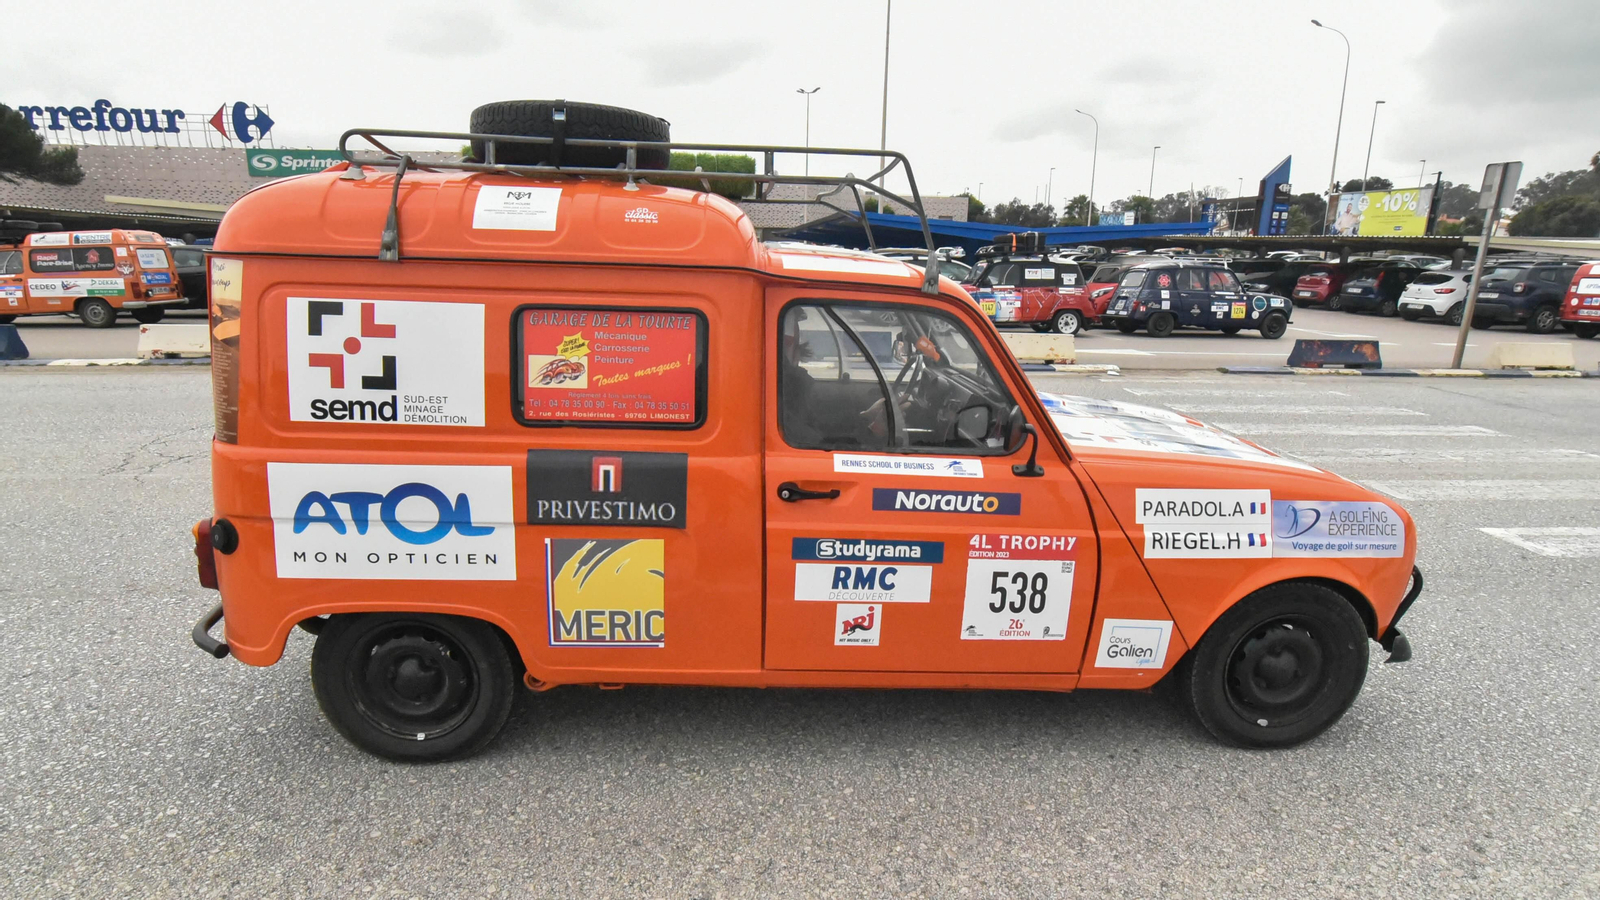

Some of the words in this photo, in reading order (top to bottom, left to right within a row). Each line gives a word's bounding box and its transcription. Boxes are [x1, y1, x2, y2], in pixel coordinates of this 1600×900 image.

[18, 98, 186, 133] rrefour
[1375, 192, 1417, 212] -10%
[36, 254, 58, 262] Rapid
[981, 303, 994, 311] 1147
[1233, 307, 1244, 315] 1274
[529, 311, 588, 326] GARAGE
[592, 313, 611, 327] DE
[615, 314, 632, 328] LA
[639, 314, 692, 330] TOURTE
[594, 331, 648, 342] Mécanique
[594, 342, 651, 354] Carrosserie
[594, 355, 635, 365] Peinture
[592, 372, 630, 388] Toutes
[634, 360, 682, 377] marques
[403, 395, 449, 404] SUD-EST
[549, 400, 559, 408] 04
[561, 400, 570, 408] 78
[573, 400, 582, 408] 35
[584, 400, 594, 409] 00
[596, 400, 606, 410] 90
[613, 401, 627, 410] Fax
[635, 401, 645, 410] 04
[647, 402, 656, 411] 78
[658, 402, 668, 411] 35
[670, 402, 679, 411] 50
[681, 402, 690, 411] 51
[310, 395, 398, 422] semd
[403, 405, 444, 414] MINAGE
[403, 414, 468, 424] DÉMOLITION
[841, 459, 867, 467] RENNES
[868, 460, 893, 469] SCHOOL
[903, 462, 935, 470] BUSINESS
[894, 491, 999, 512] Norauto
[292, 482, 496, 545] ATOL
[537, 500, 676, 521] PRIVESTIMO
[1143, 501, 1244, 517] PARADOL.A
[1328, 510, 1338, 523] A
[1328, 523, 1398, 536] EXPERIENCE
[969, 534, 992, 549] 4L
[999, 535, 1077, 551] TROPHY
[1152, 532, 1241, 550] RIEGEL.H
[1291, 541, 1324, 551] Voyage
[1325, 541, 1337, 550] de
[1337, 541, 1353, 551] golf
[820, 540, 921, 561] Studyrama
[968, 550, 995, 558] ÉDITION
[293, 551, 347, 563] MON
[366, 552, 498, 565] OPTICIEN
[831, 566, 898, 591] RMC
[828, 590, 895, 601] DÉCOUVERTE
[988, 571, 1048, 614] 538
[554, 609, 665, 641] MERIC
[841, 605, 875, 636] NRJ
[999, 629, 1031, 637] ÉDITION
[1109, 635, 1131, 644] Cours
[1106, 644, 1153, 658] Galien
